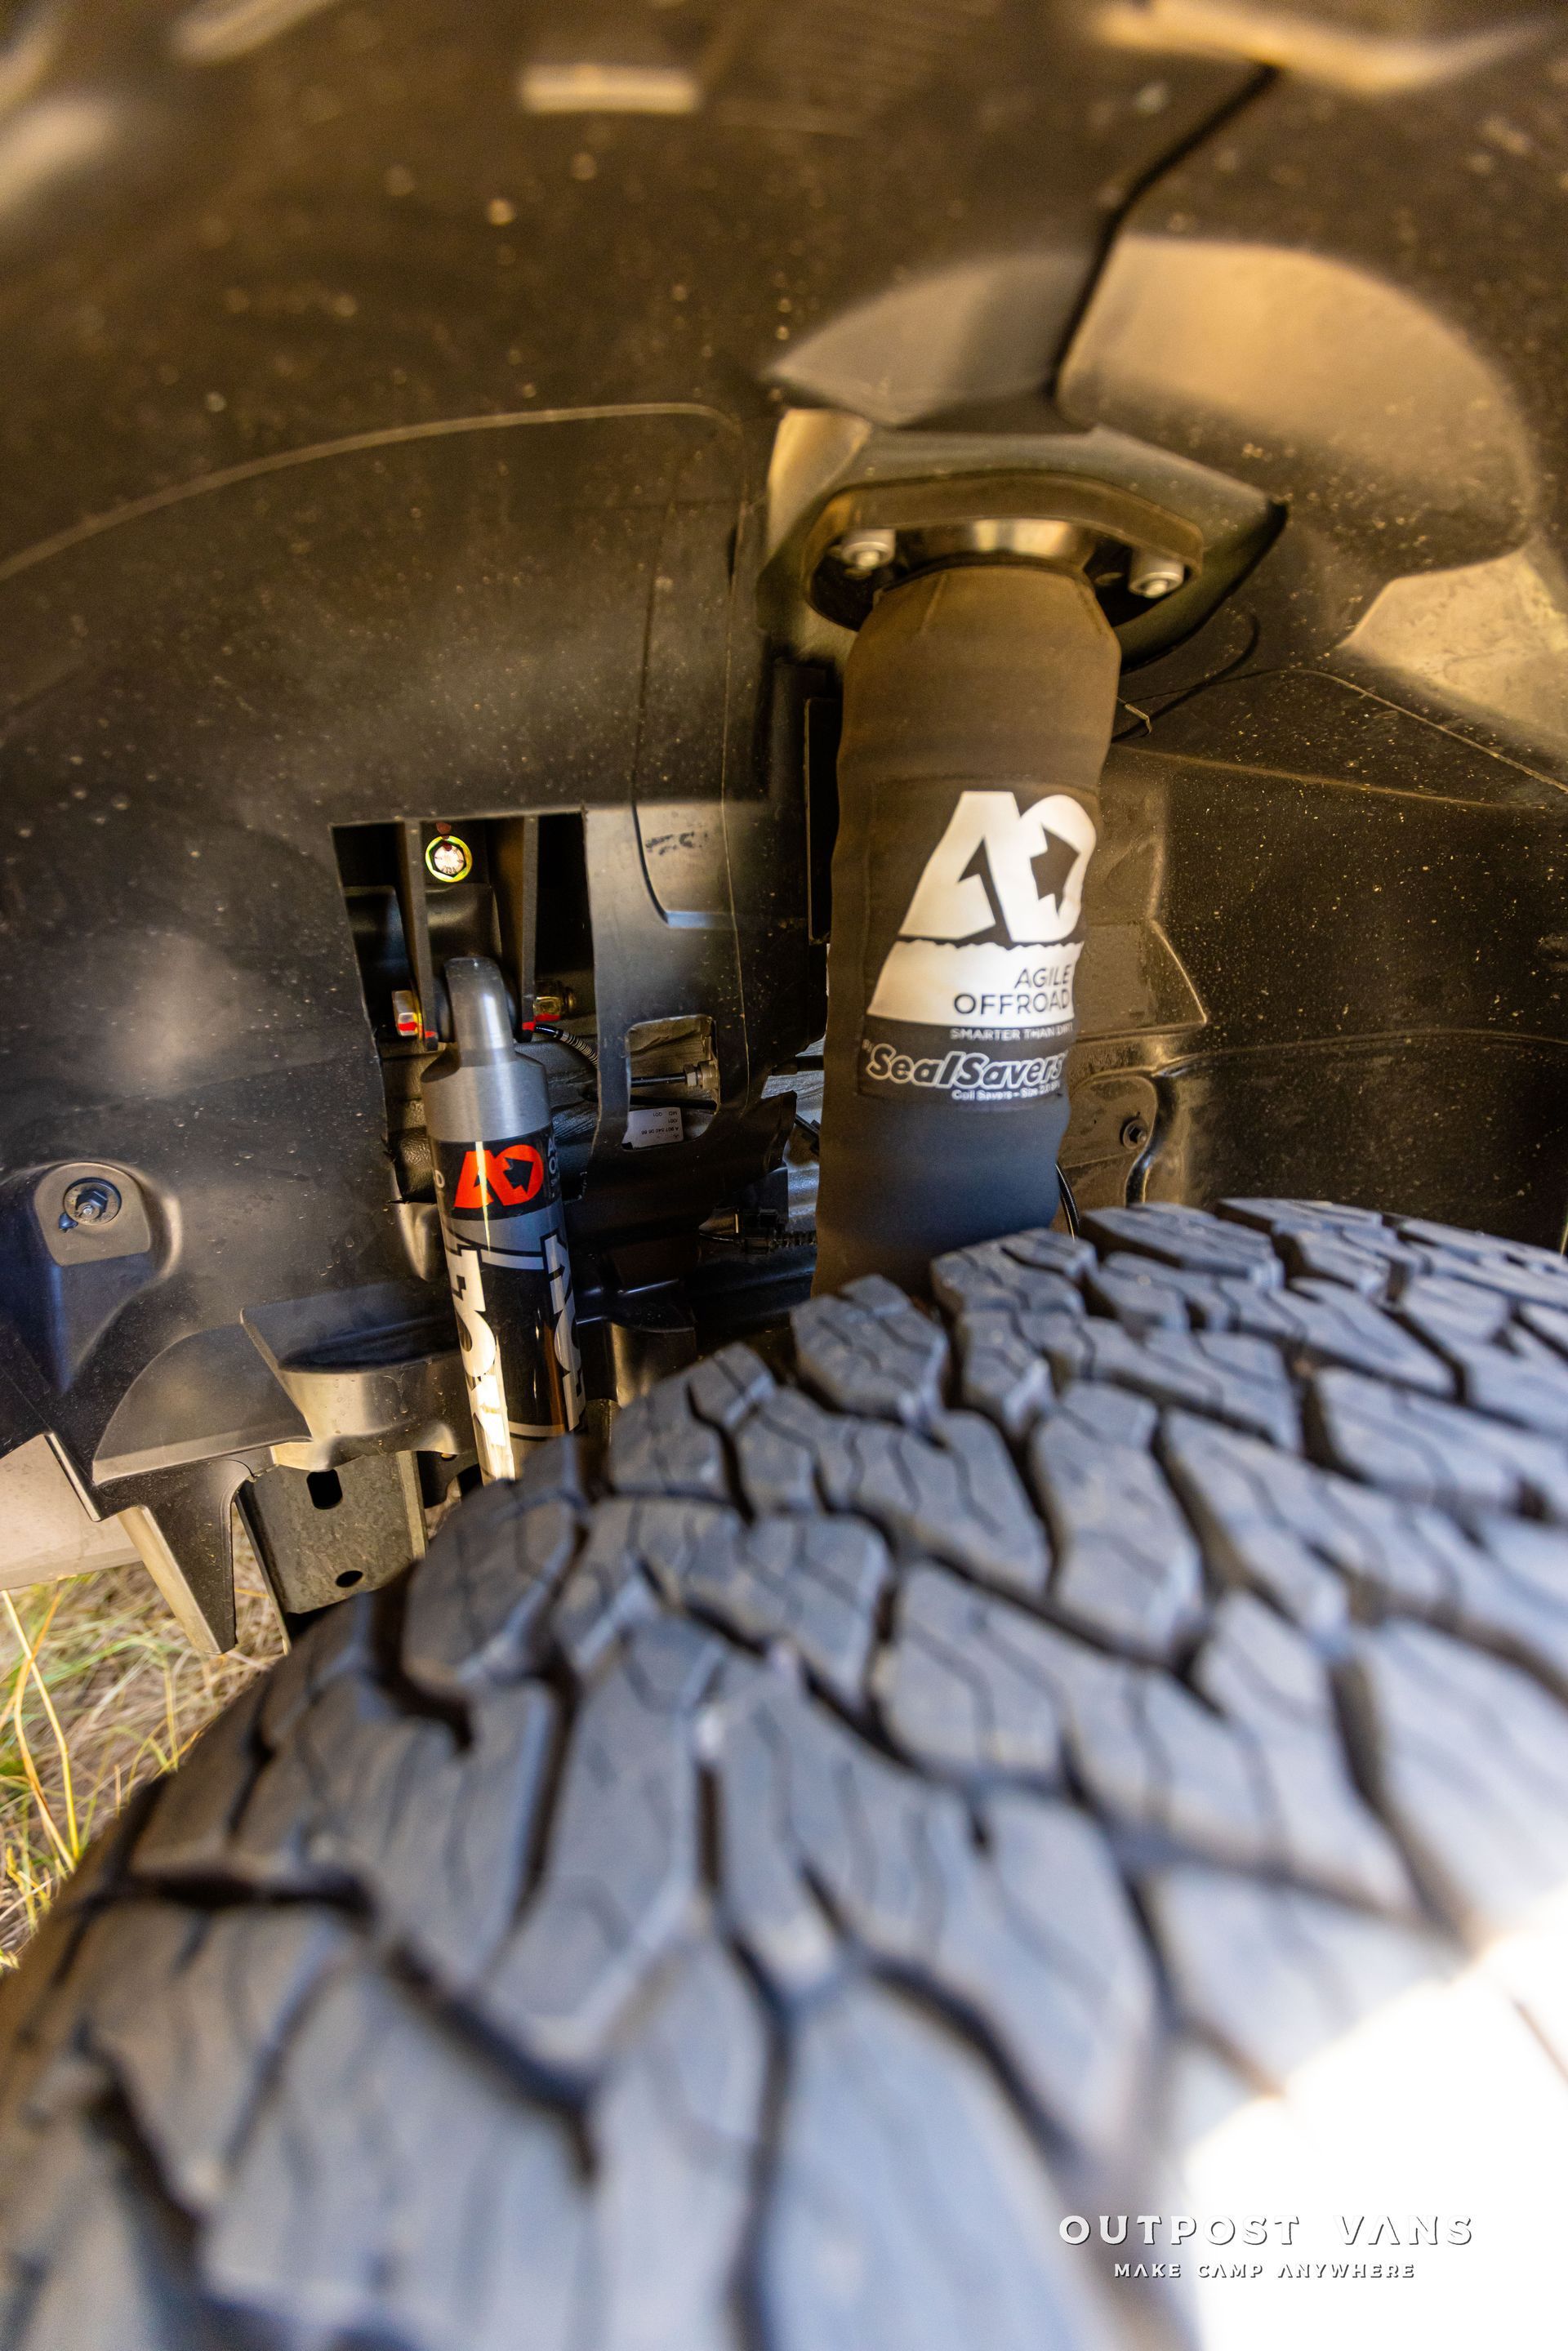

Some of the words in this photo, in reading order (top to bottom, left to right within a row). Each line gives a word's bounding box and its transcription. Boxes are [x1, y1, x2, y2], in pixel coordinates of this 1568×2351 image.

[1014, 964, 1072, 989] AGILE
[953, 988, 1071, 1016] OFFROAD
[950, 1028, 1020, 1041] SMARTER
[1022, 1026, 1055, 1040] THAN
[951, 1089, 975, 1101] Coil
[976, 1089, 1013, 1102] Savers
